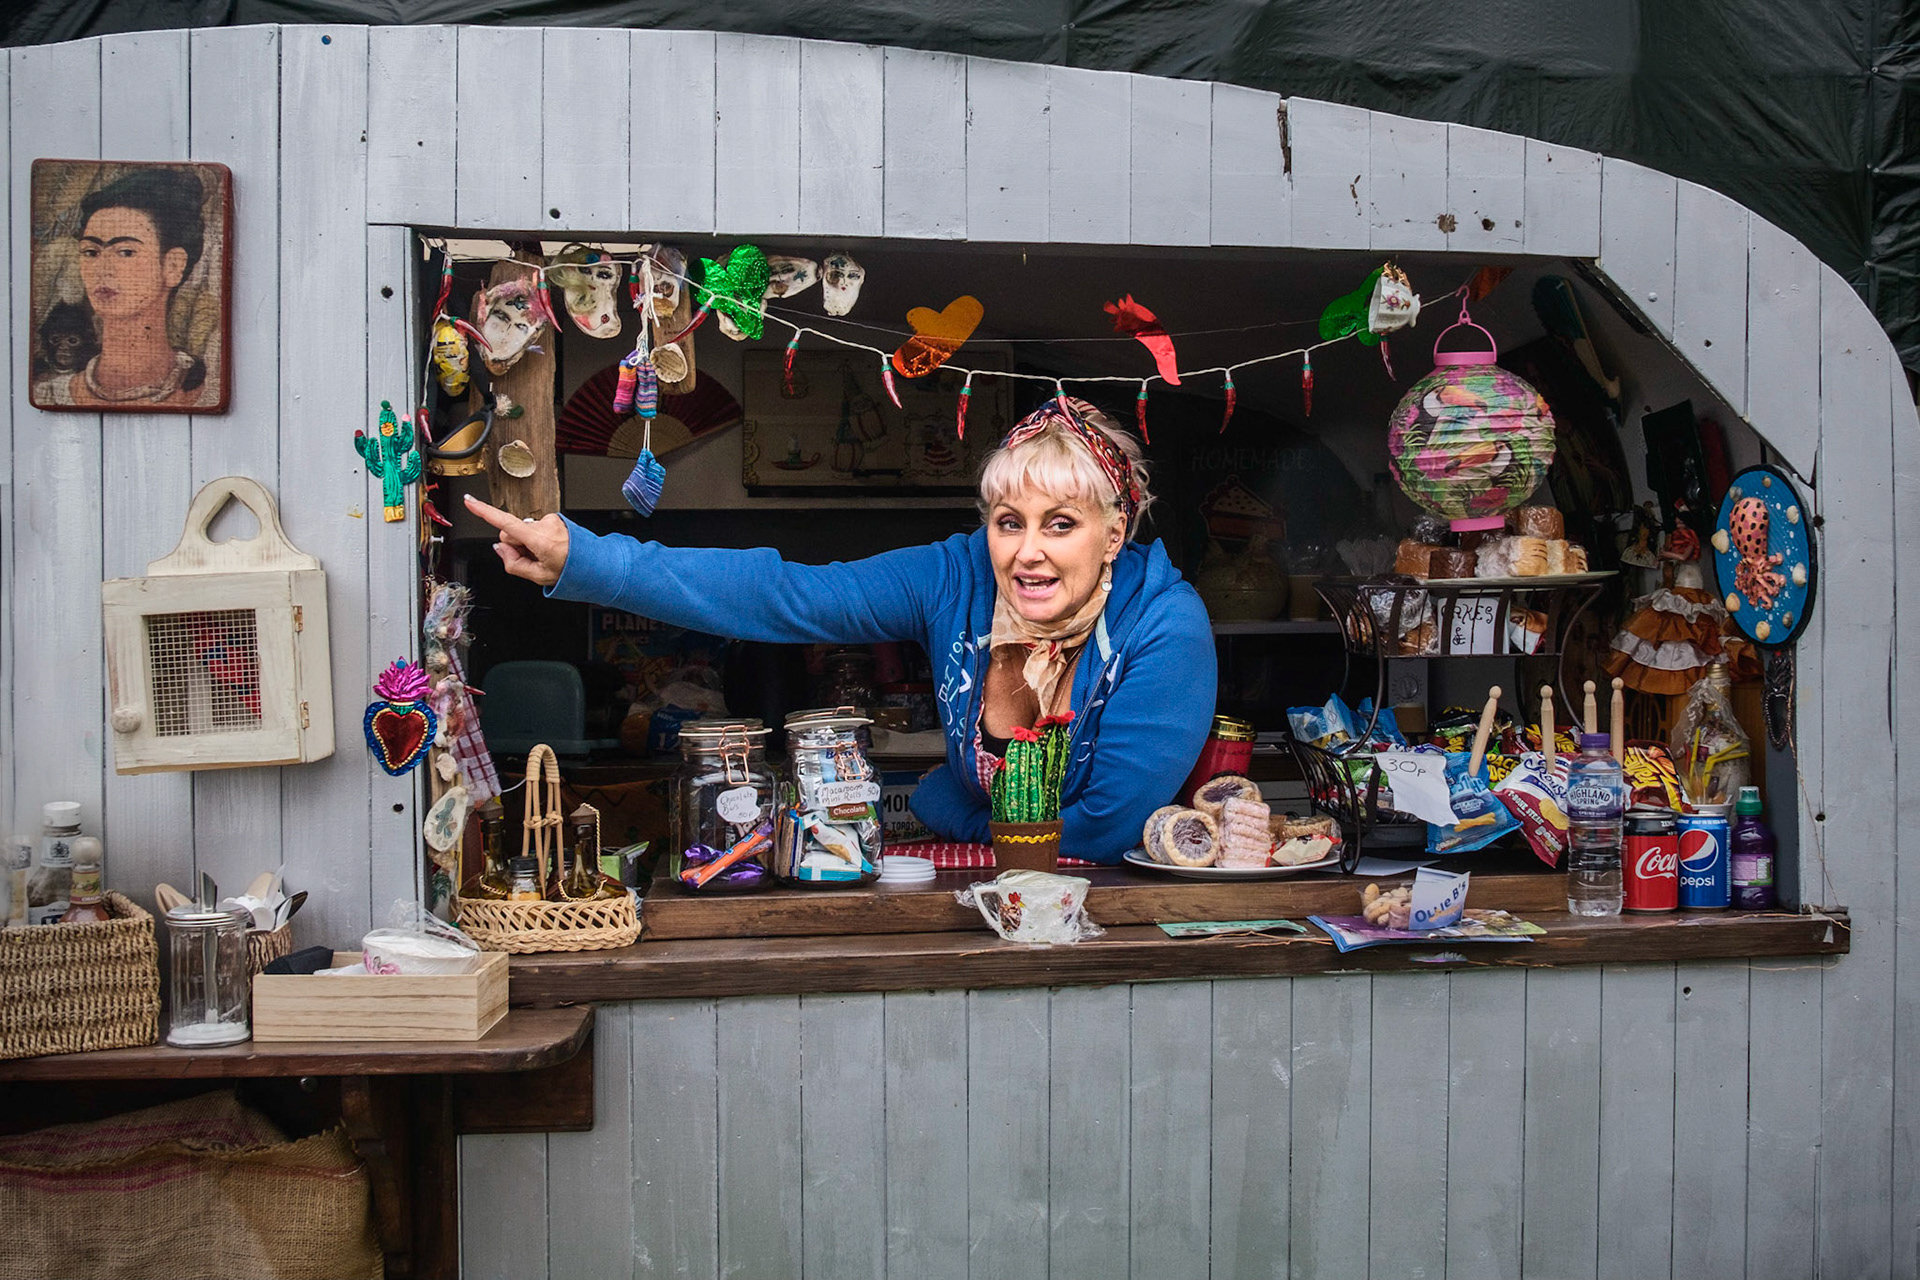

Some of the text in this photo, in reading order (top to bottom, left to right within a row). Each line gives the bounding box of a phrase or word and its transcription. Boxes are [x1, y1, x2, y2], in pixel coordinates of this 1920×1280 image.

[1191, 446, 1307, 471] HOMEMADE
[1385, 758, 1427, 777] 30p
[1570, 788, 1611, 802] HIGHLAND
[1576, 798, 1600, 806] SPRING
[833, 805, 866, 816] Chocolate
[1680, 874, 1715, 889] pepsi
